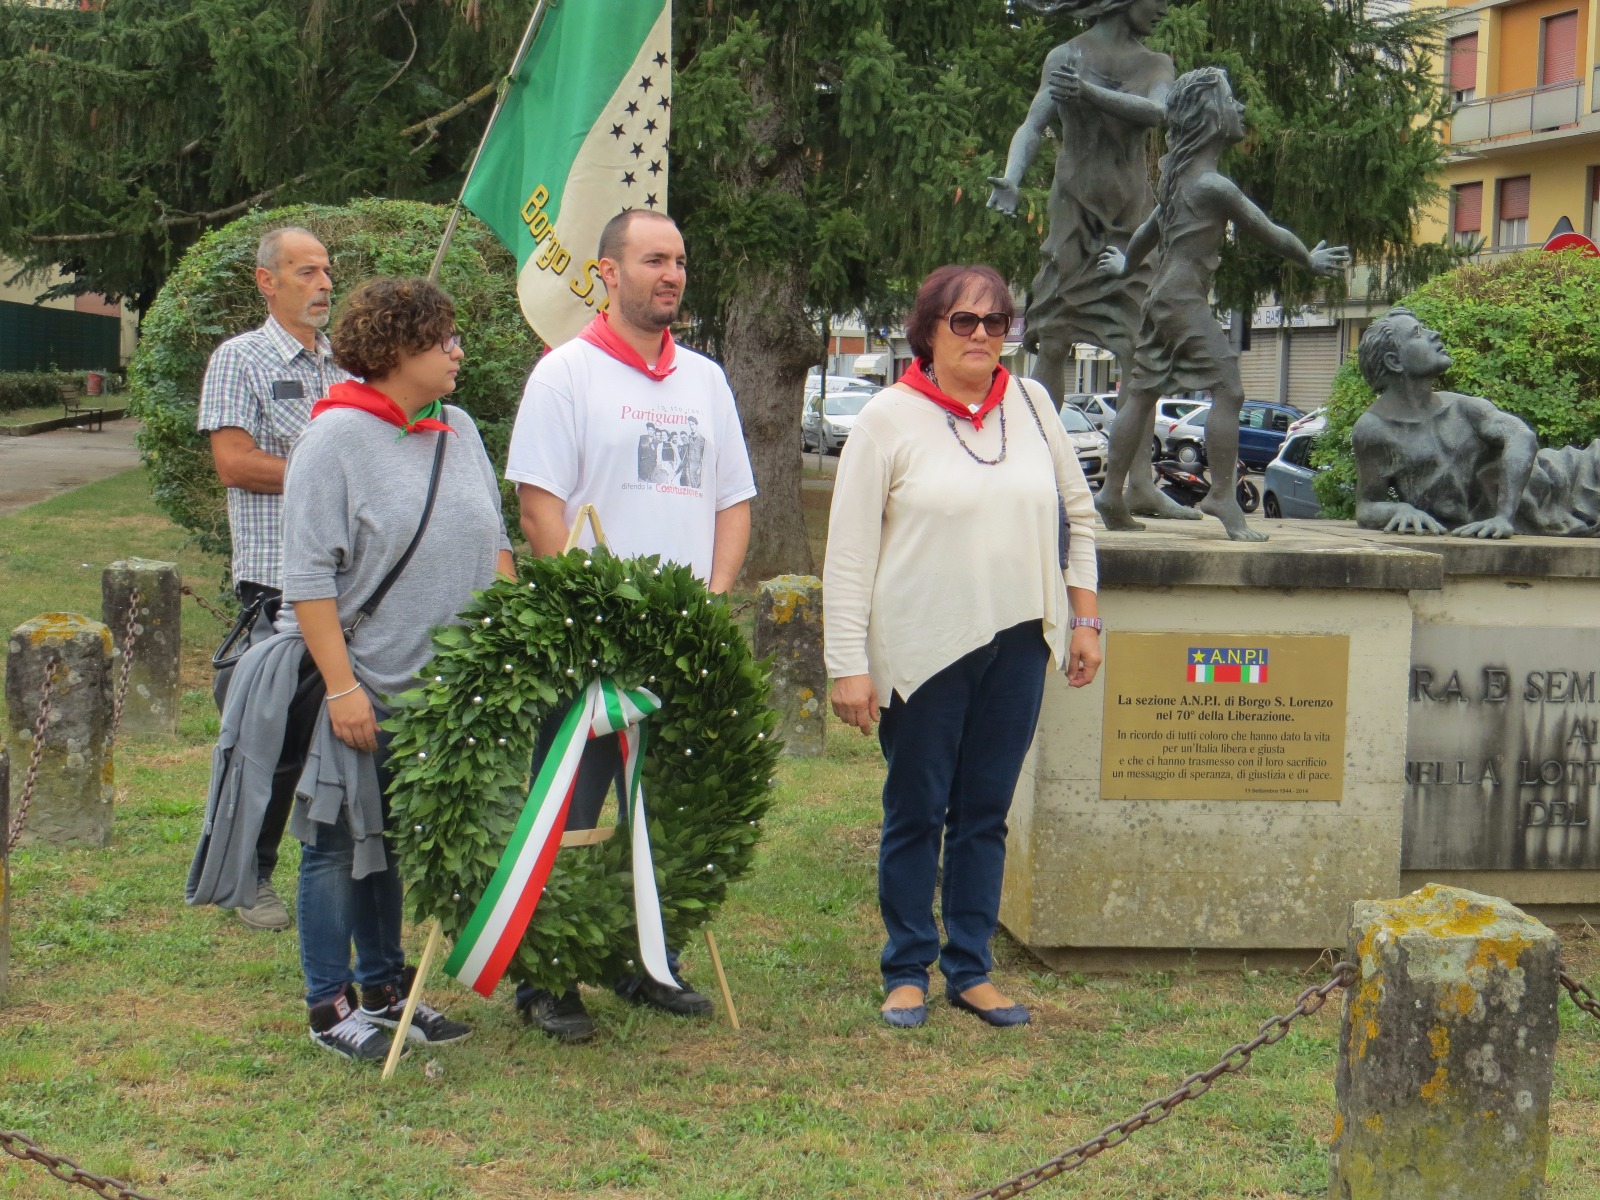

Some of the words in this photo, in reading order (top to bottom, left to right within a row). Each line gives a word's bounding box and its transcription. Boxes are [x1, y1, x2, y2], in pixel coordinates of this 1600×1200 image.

[520, 183, 571, 275] Borgo
[569, 258, 601, 306] S.
[620, 405, 688, 427] Partigiani
[621, 483, 646, 491] difendo
[655, 482, 699, 498] Costituzione
[1209, 649, 1265, 665] A.N.P.I.
[1482, 669, 1510, 703] E
[1523, 671, 1600, 703] SEM
[1118, 694, 1132, 705] La
[1135, 695, 1177, 706] sezione
[1180, 695, 1221, 706] A.N.P.I.
[1224, 696, 1235, 707] di
[1238, 696, 1271, 709] Borgo
[1274, 696, 1286, 707] S.
[1289, 696, 1334, 708] Lorenzo
[1156, 710, 1173, 720] nel
[1177, 710, 1195, 721] 70°
[1198, 710, 1224, 721] della
[1228, 711, 1295, 722] Liberazione.
[1117, 729, 1127, 740] In
[1129, 730, 1163, 740] ricordo
[1166, 730, 1175, 740] di
[1178, 731, 1197, 740] tutti
[1199, 731, 1228, 741] coloro
[1231, 731, 1247, 741] che
[1250, 731, 1278, 741] hanno
[1280, 731, 1301, 741] dato
[1303, 732, 1312, 741] la
[1315, 732, 1330, 742] vita
[1162, 745, 1178, 755] per
[1181, 743, 1218, 753] un'Italia
[1221, 743, 1247, 754] libera
[1249, 746, 1255, 754] e
[1258, 744, 1285, 756] giusta
[1119, 758, 1125, 766] e
[1127, 756, 1143, 766] che
[1146, 756, 1155, 766] ci
[1157, 756, 1186, 766] hanno
[1189, 757, 1235, 767] trasmesso
[1237, 759, 1254, 767] con
[1257, 757, 1263, 767] il
[1265, 757, 1284, 767] loro
[1286, 757, 1327, 767] sacrificio
[1126, 769, 1175, 781] messaggio
[1178, 769, 1187, 779] di
[1190, 770, 1234, 781] speranza,
[1236, 770, 1246, 779] di
[1248, 770, 1286, 782] giustizia
[1288, 772, 1294, 780] e
[1296, 770, 1306, 780] di
[1308, 773, 1333, 782] pace.
[1526, 802, 1588, 827] DEL
